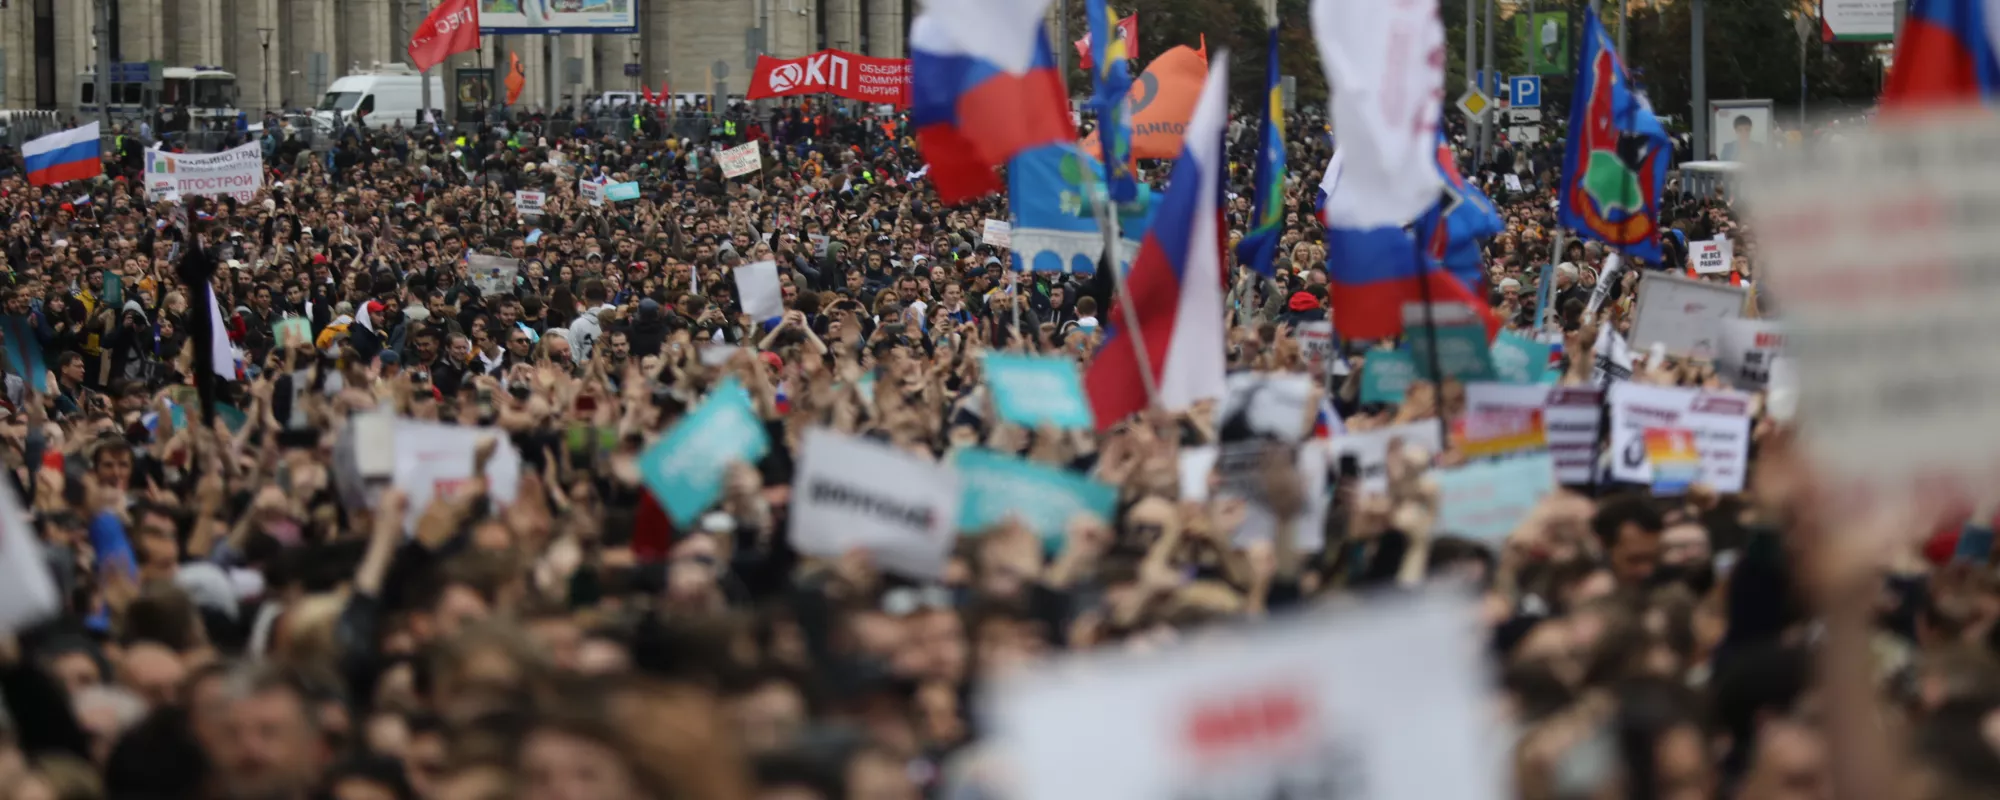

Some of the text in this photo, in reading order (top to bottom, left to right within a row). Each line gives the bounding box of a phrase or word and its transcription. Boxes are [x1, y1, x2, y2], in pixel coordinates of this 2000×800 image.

[859, 63, 913, 75] ОБЪЕДИНЕ
[859, 74, 914, 84] КОММУНИС
[858, 85, 900, 95] ПАРТИЯ
[178, 173, 253, 191] ЛГОСТРОЙ
